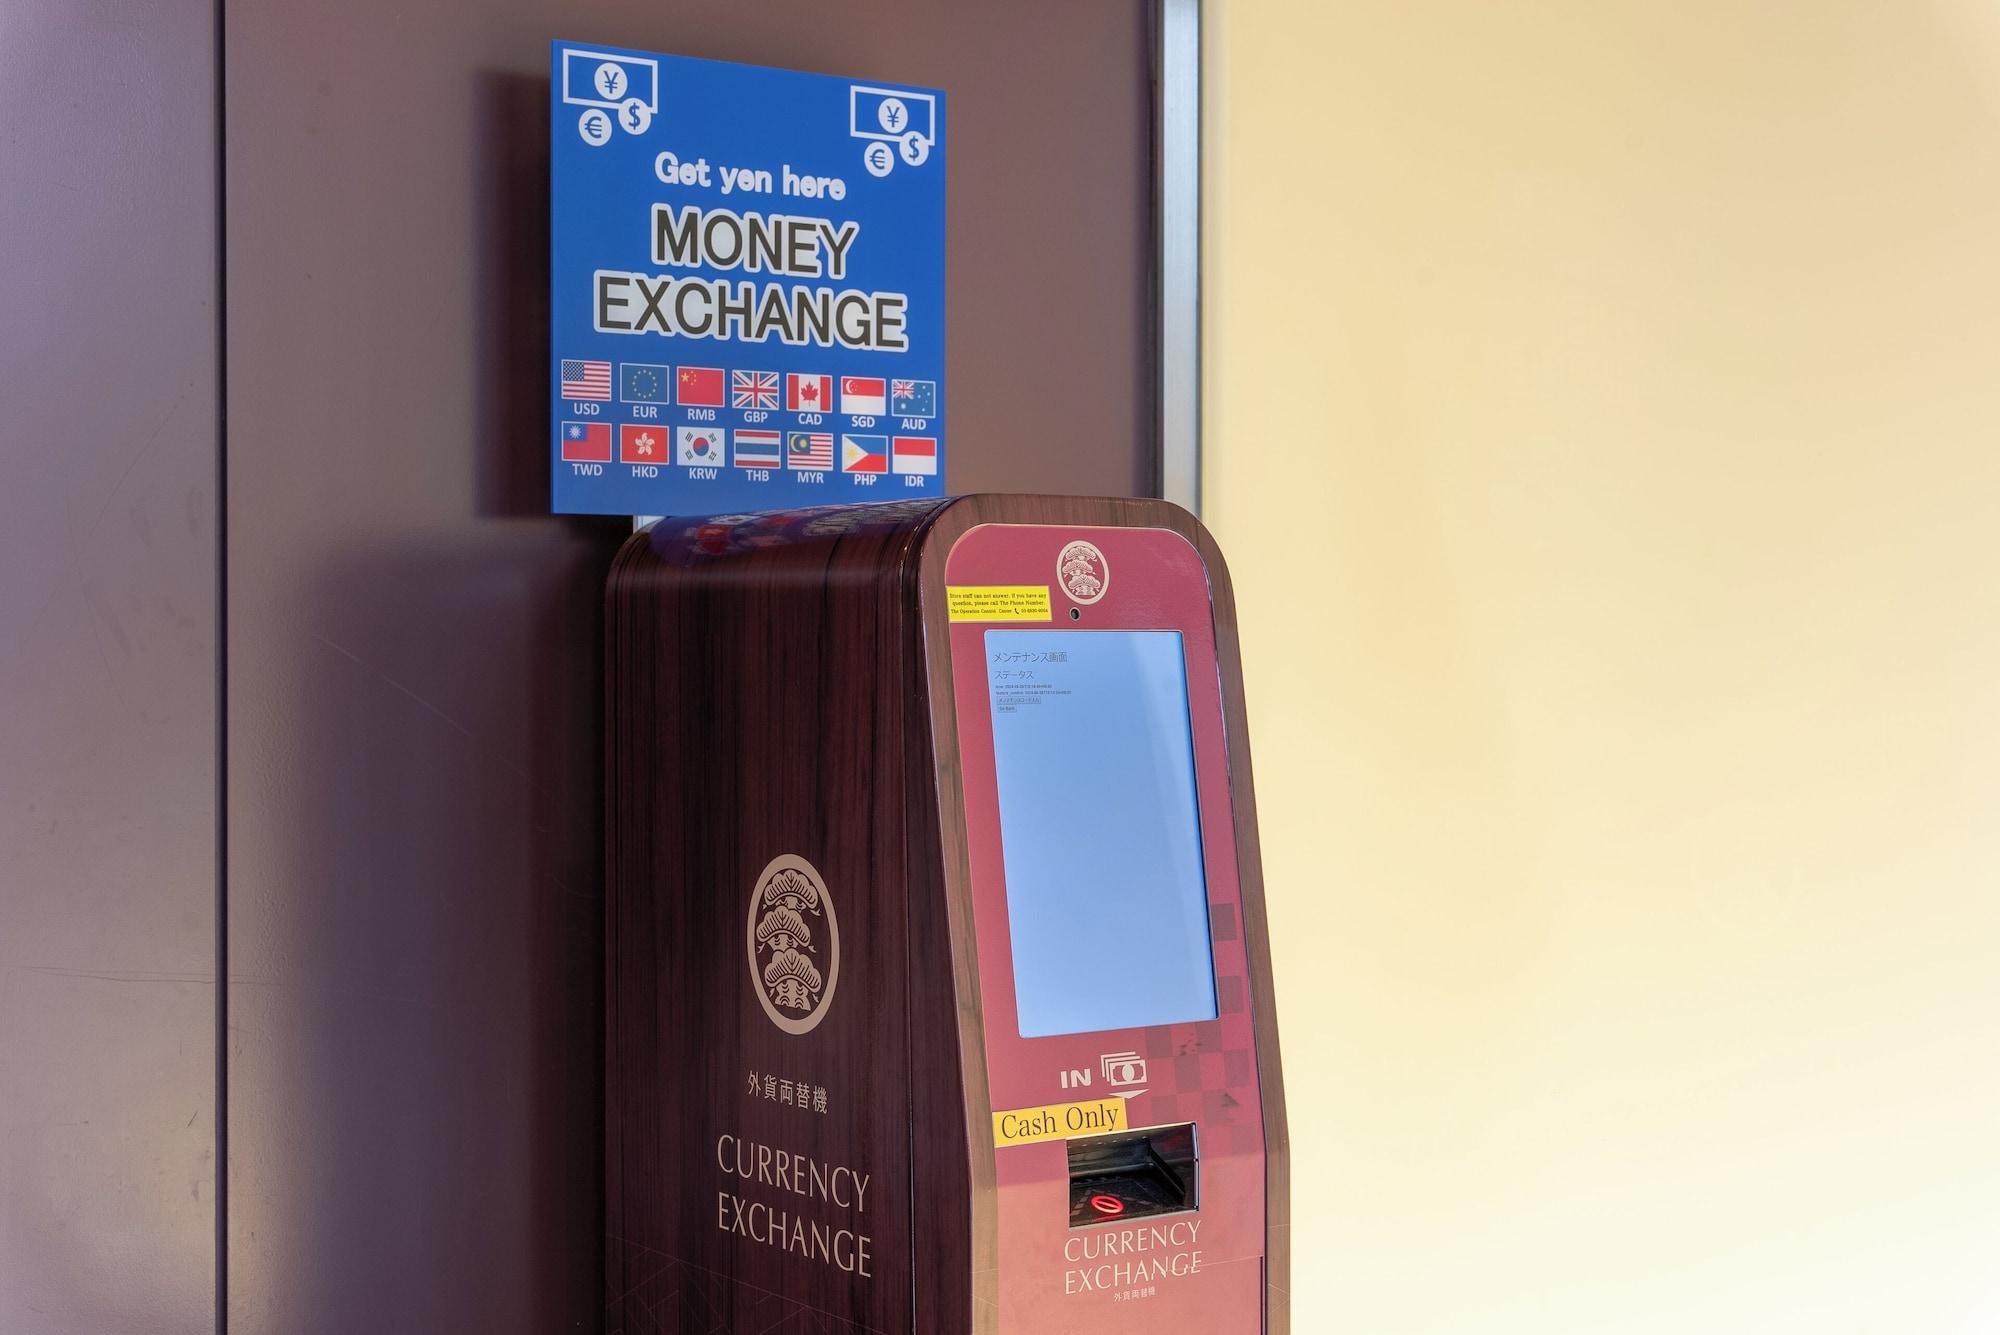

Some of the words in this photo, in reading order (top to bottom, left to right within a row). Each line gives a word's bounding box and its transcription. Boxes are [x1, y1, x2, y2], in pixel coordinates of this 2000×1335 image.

[655, 151, 711, 188] Get
[719, 165, 772, 195] yen
[782, 164, 846, 200] here
[654, 206, 857, 278] MONEY
[597, 274, 906, 349] EXCHANGE
[573, 402, 600, 417] USD
[632, 405, 658, 419] EUR
[687, 408, 716, 422] RMB
[743, 410, 769, 424] GBP
[798, 412, 823, 426] CAD
[851, 414, 876, 429] SGD
[901, 417, 927, 431] AUD
[572, 463, 603, 477] TWD
[631, 464, 659, 478] HKD
[688, 467, 718, 480] KRW
[745, 469, 770, 482] THB
[797, 471, 824, 484] MYR
[854, 473, 878, 486] PHP
[904, 474, 924, 488] IDR
[993, 651, 1068, 663] メンテナンス画面
[994, 670, 1034, 680] ステータス
[748, 1070, 828, 1114] 外貨両替機
[1060, 1068, 1092, 1089] IN
[1001, 1110, 1057, 1139] Cash
[1066, 1104, 1119, 1132] Only
[717, 1134, 870, 1212] CURRENCY
[718, 1191, 871, 1278] EXCHANGE
[1064, 1220, 1202, 1262] CURRENCY
[1065, 1251, 1203, 1295] EXCHANGE
